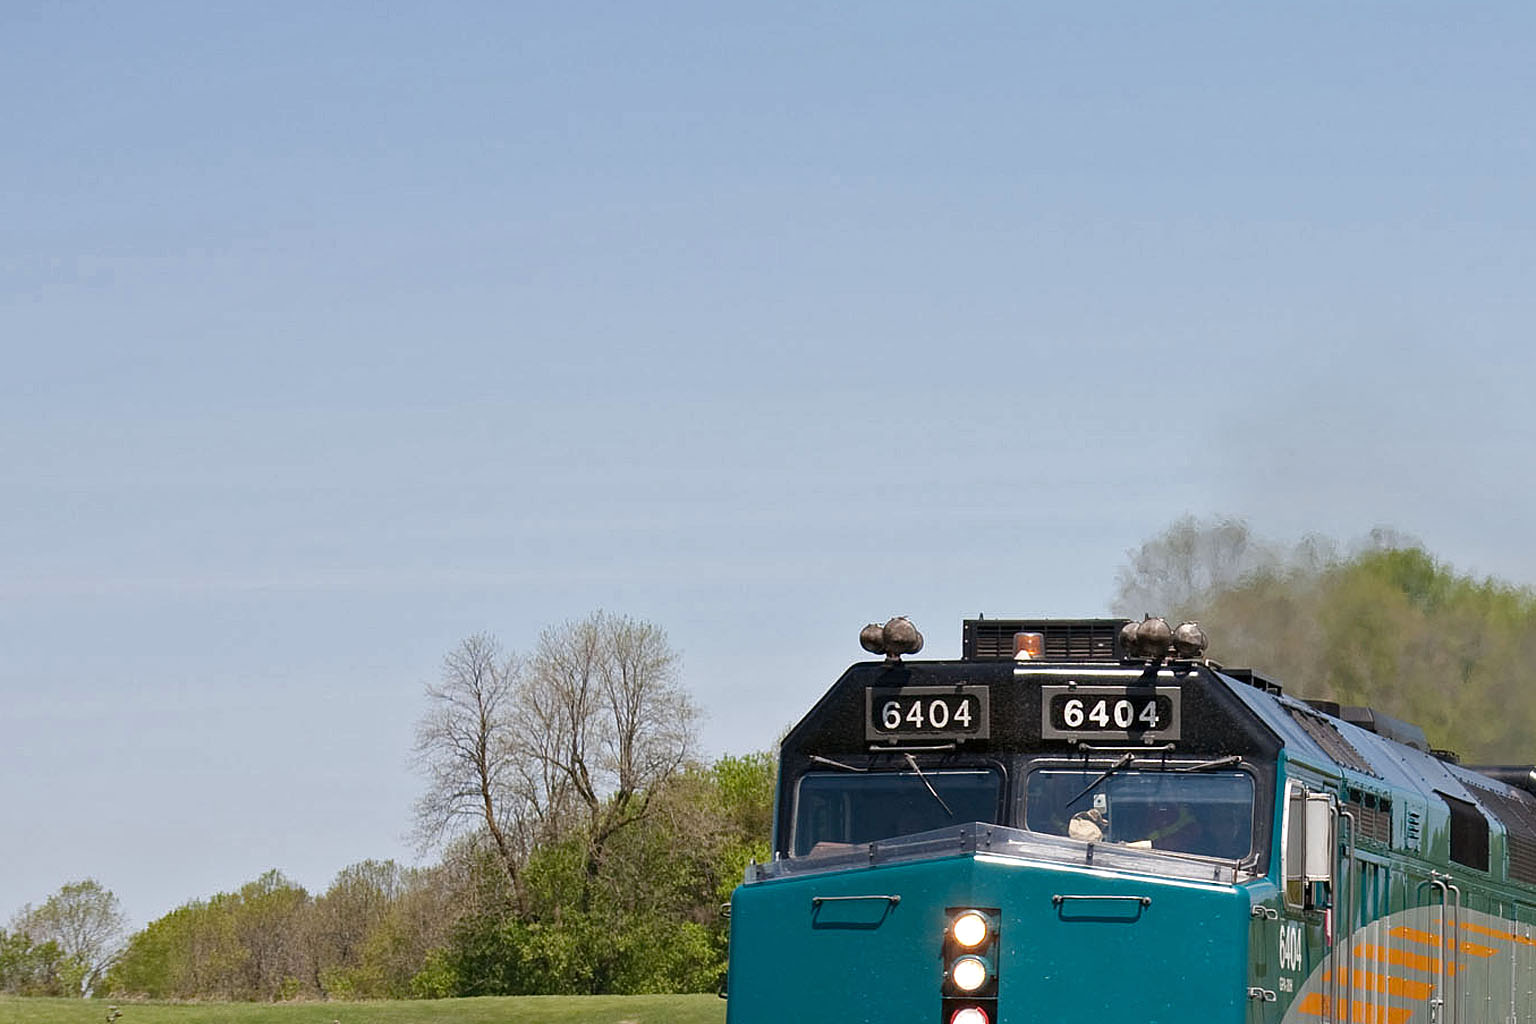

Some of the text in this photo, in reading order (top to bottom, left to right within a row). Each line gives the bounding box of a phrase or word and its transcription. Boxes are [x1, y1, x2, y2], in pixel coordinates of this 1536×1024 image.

[883, 700, 972, 729] 6404
[1064, 700, 1159, 728] 6404
[1279, 924, 1302, 972] 6404
